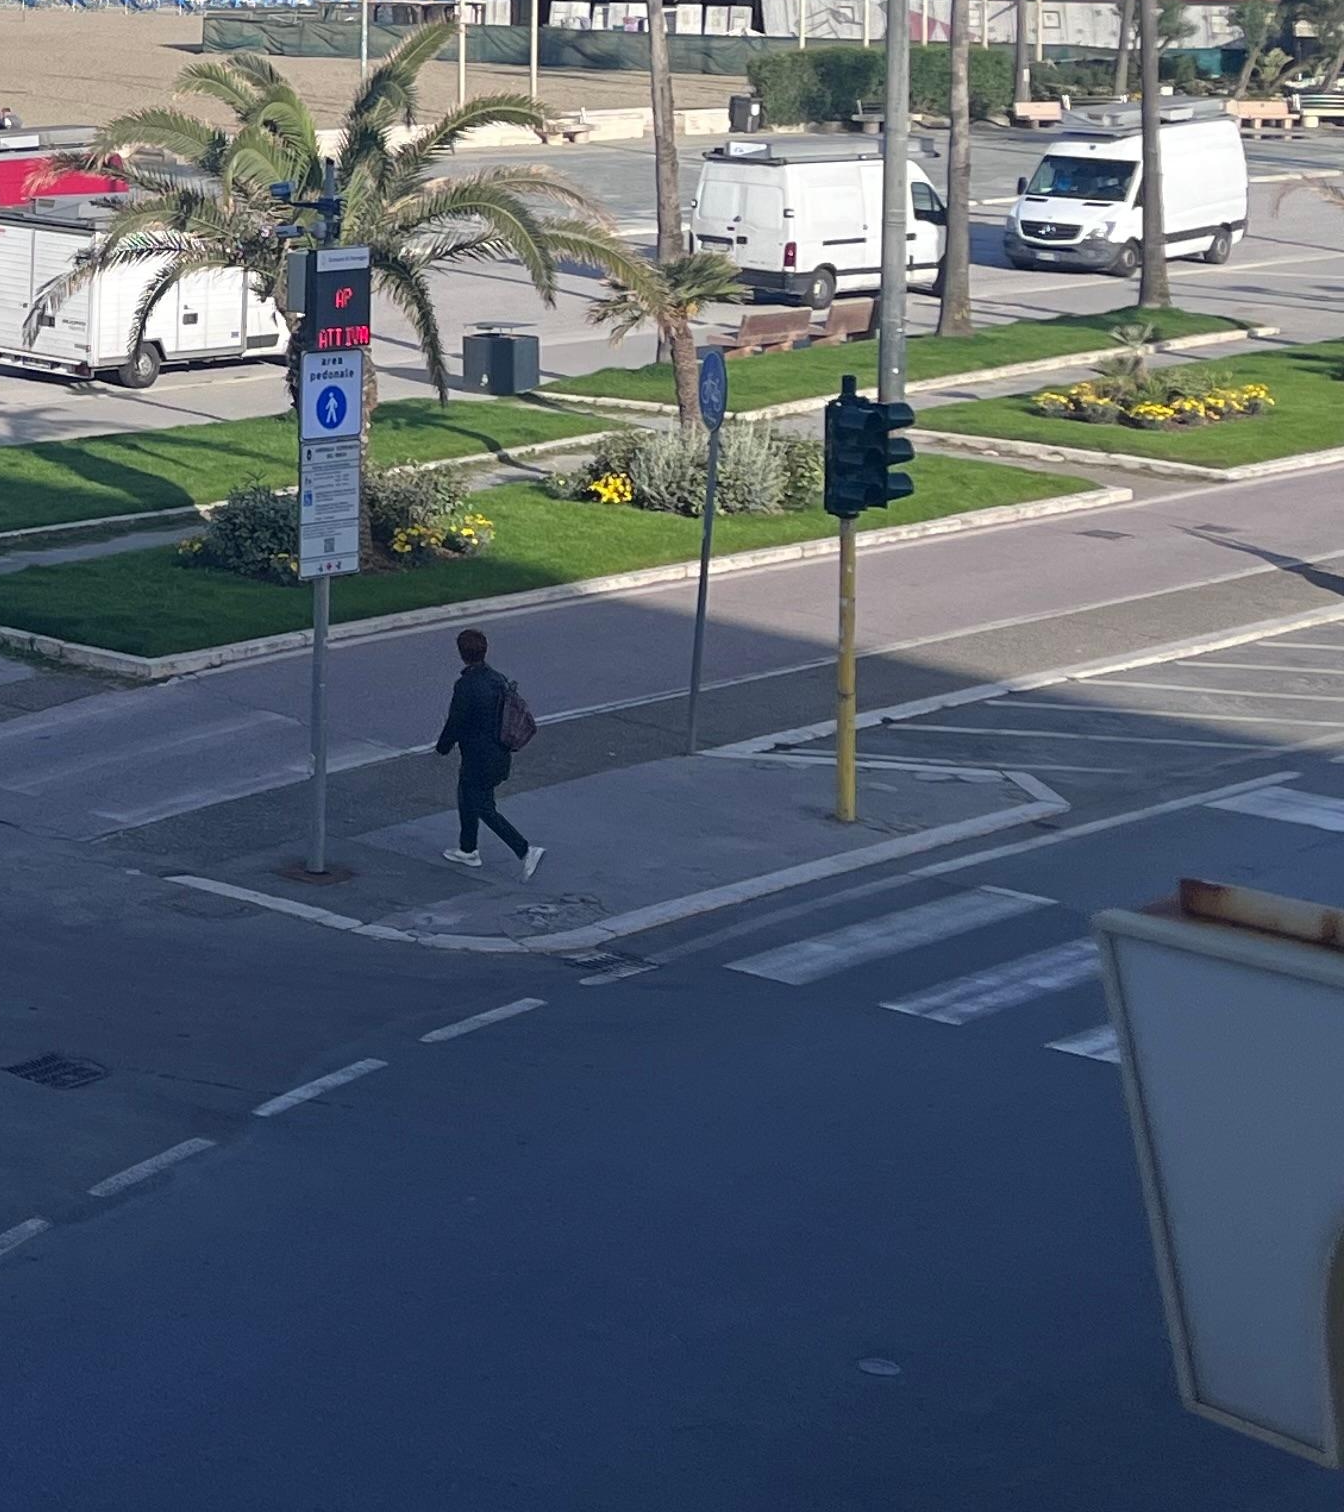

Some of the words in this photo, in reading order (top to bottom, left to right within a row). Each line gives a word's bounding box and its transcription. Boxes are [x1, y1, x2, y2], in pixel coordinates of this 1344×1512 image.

[335, 286, 353, 310] AP
[318, 326, 369, 349] ATTIVA
[321, 356, 343, 366] area
[310, 369, 354, 382] pedonale
